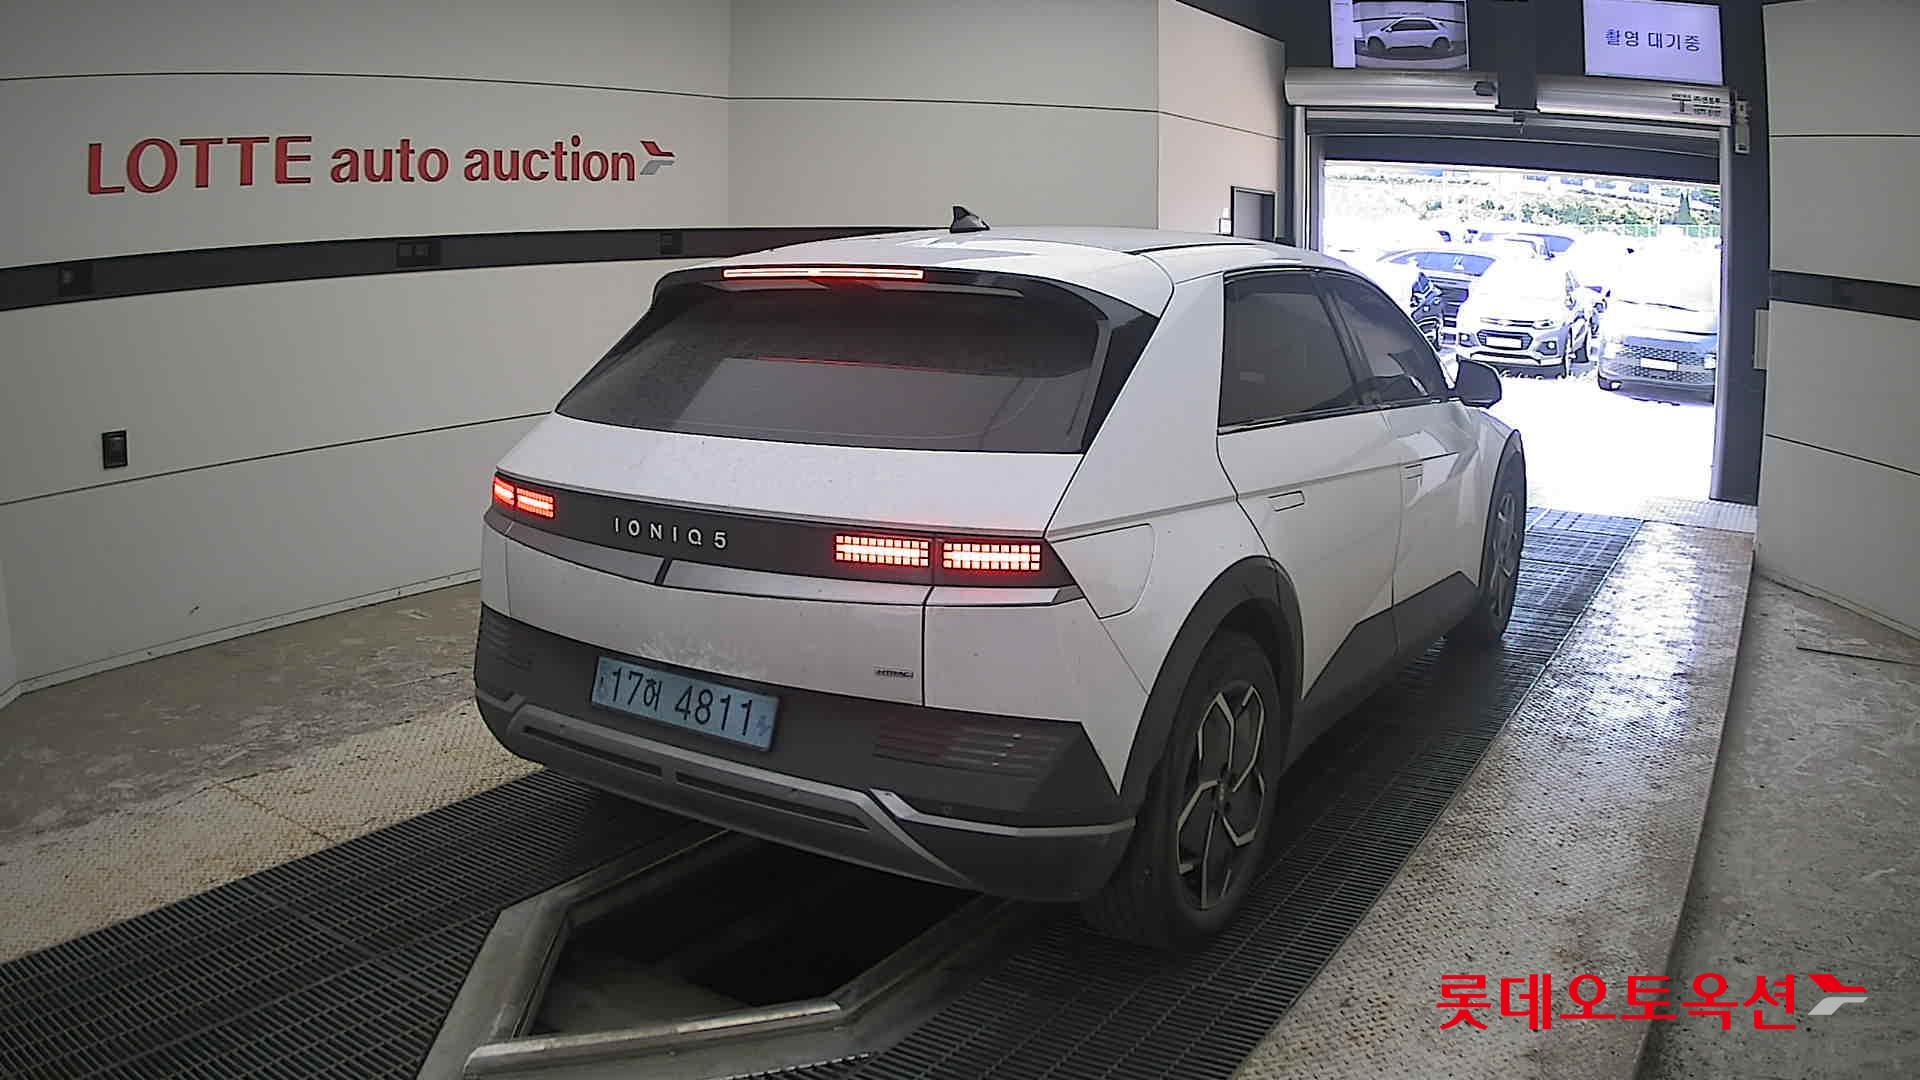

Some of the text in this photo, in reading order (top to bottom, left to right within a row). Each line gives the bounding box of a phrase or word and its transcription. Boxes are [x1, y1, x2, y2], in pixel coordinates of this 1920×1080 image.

[1605, 28, 1701, 52] 촬영 대기중
[87, 134, 637, 195] LOTTE auto auction
[614, 516, 727, 549] IONIQ 5
[612, 667, 753, 736] 17허 4811
